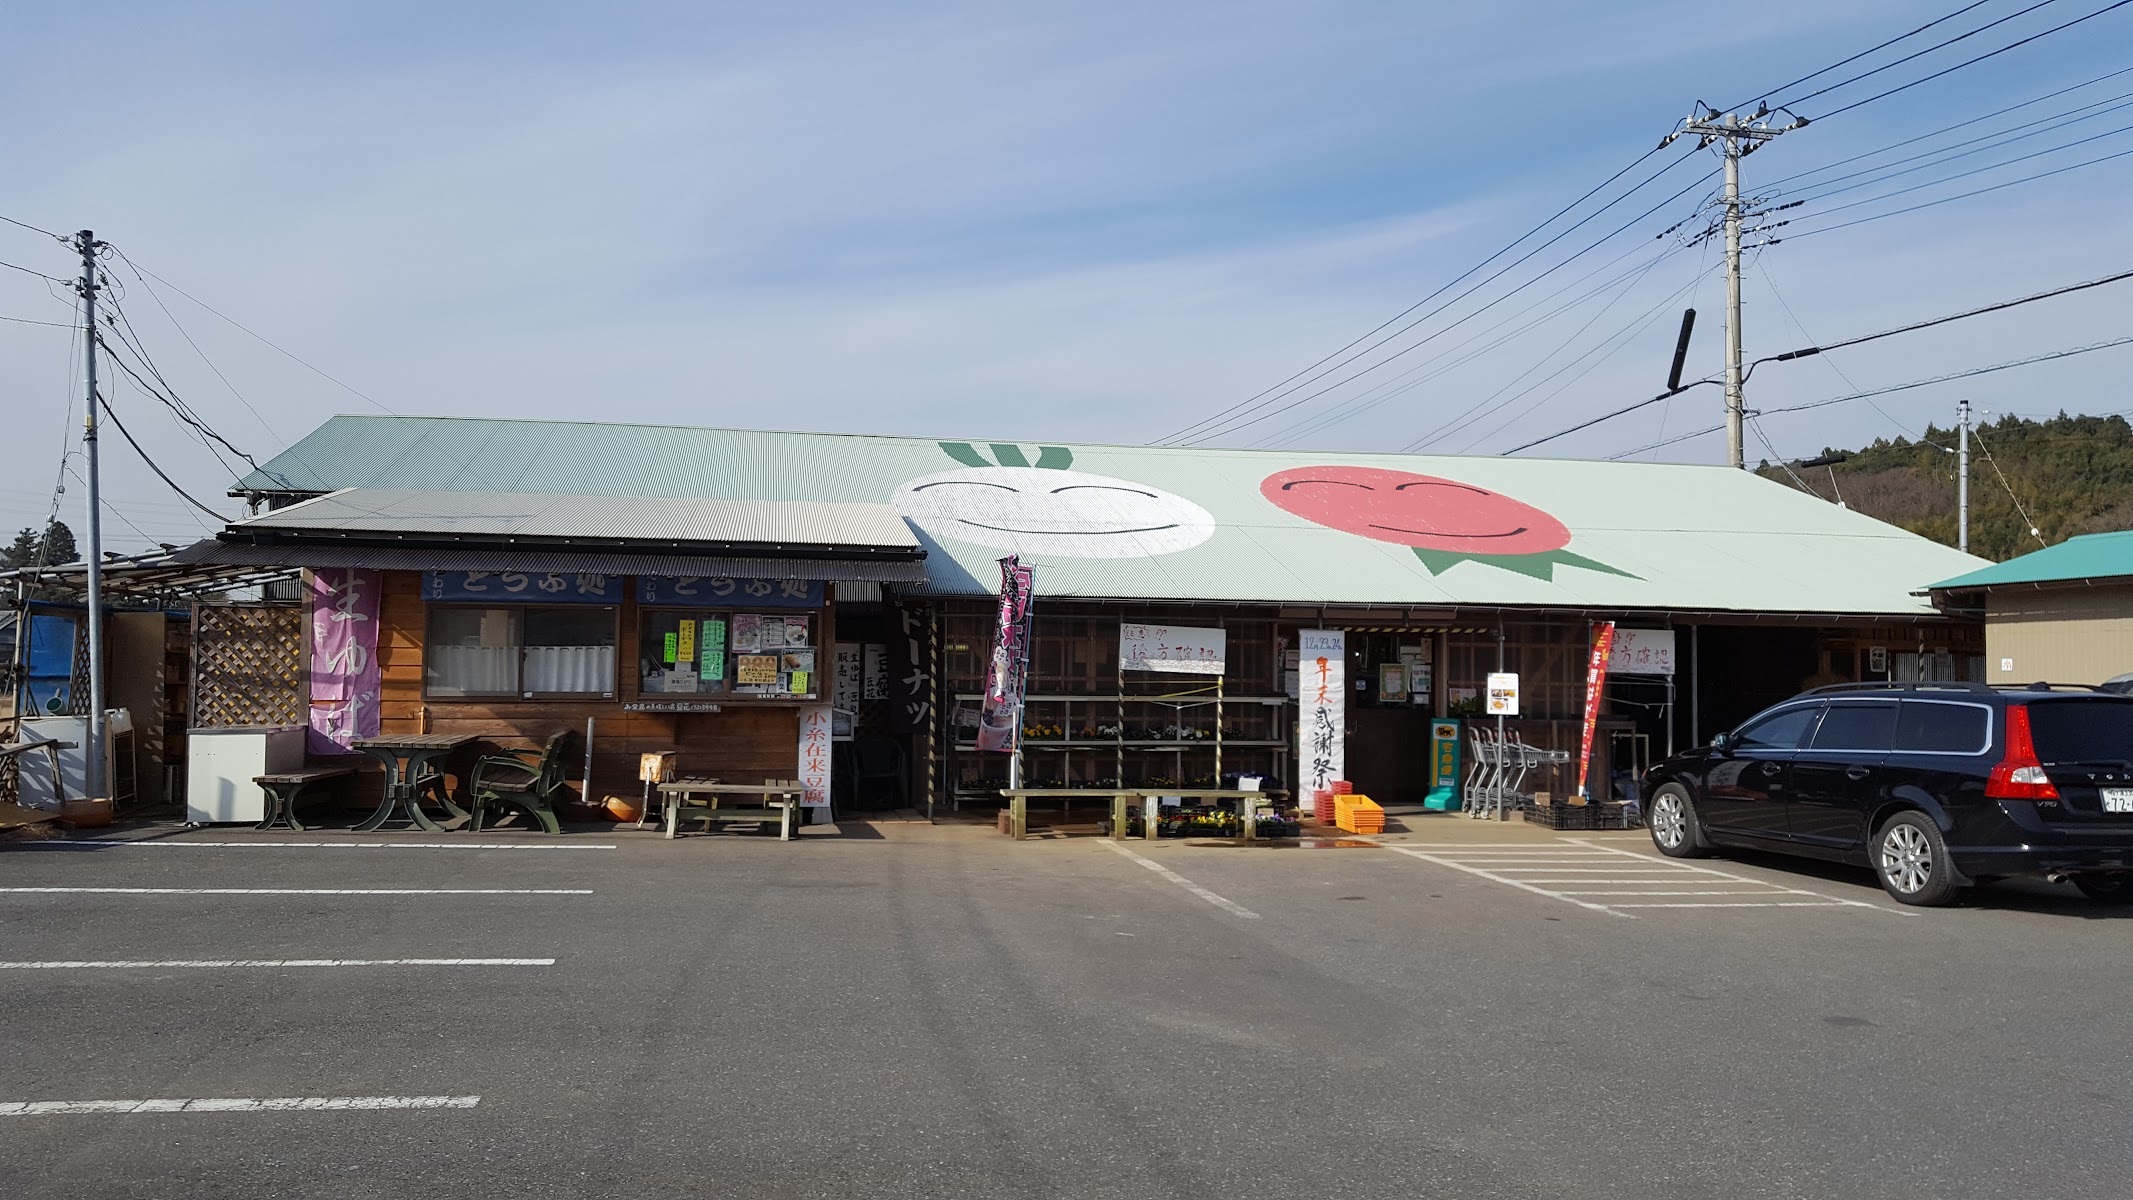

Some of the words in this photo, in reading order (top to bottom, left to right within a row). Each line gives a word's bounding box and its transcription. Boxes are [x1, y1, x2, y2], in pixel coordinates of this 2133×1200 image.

[432, 571, 444, 599] わり
[326, 569, 375, 744] 生ゆば
[902, 607, 930, 725] ドーナツ
[804, 711, 826, 804] 小糸在来豆腐
[1311, 656, 1337, 790] 年末感謝祭
[2111, 798, 2133, 811] 72-
